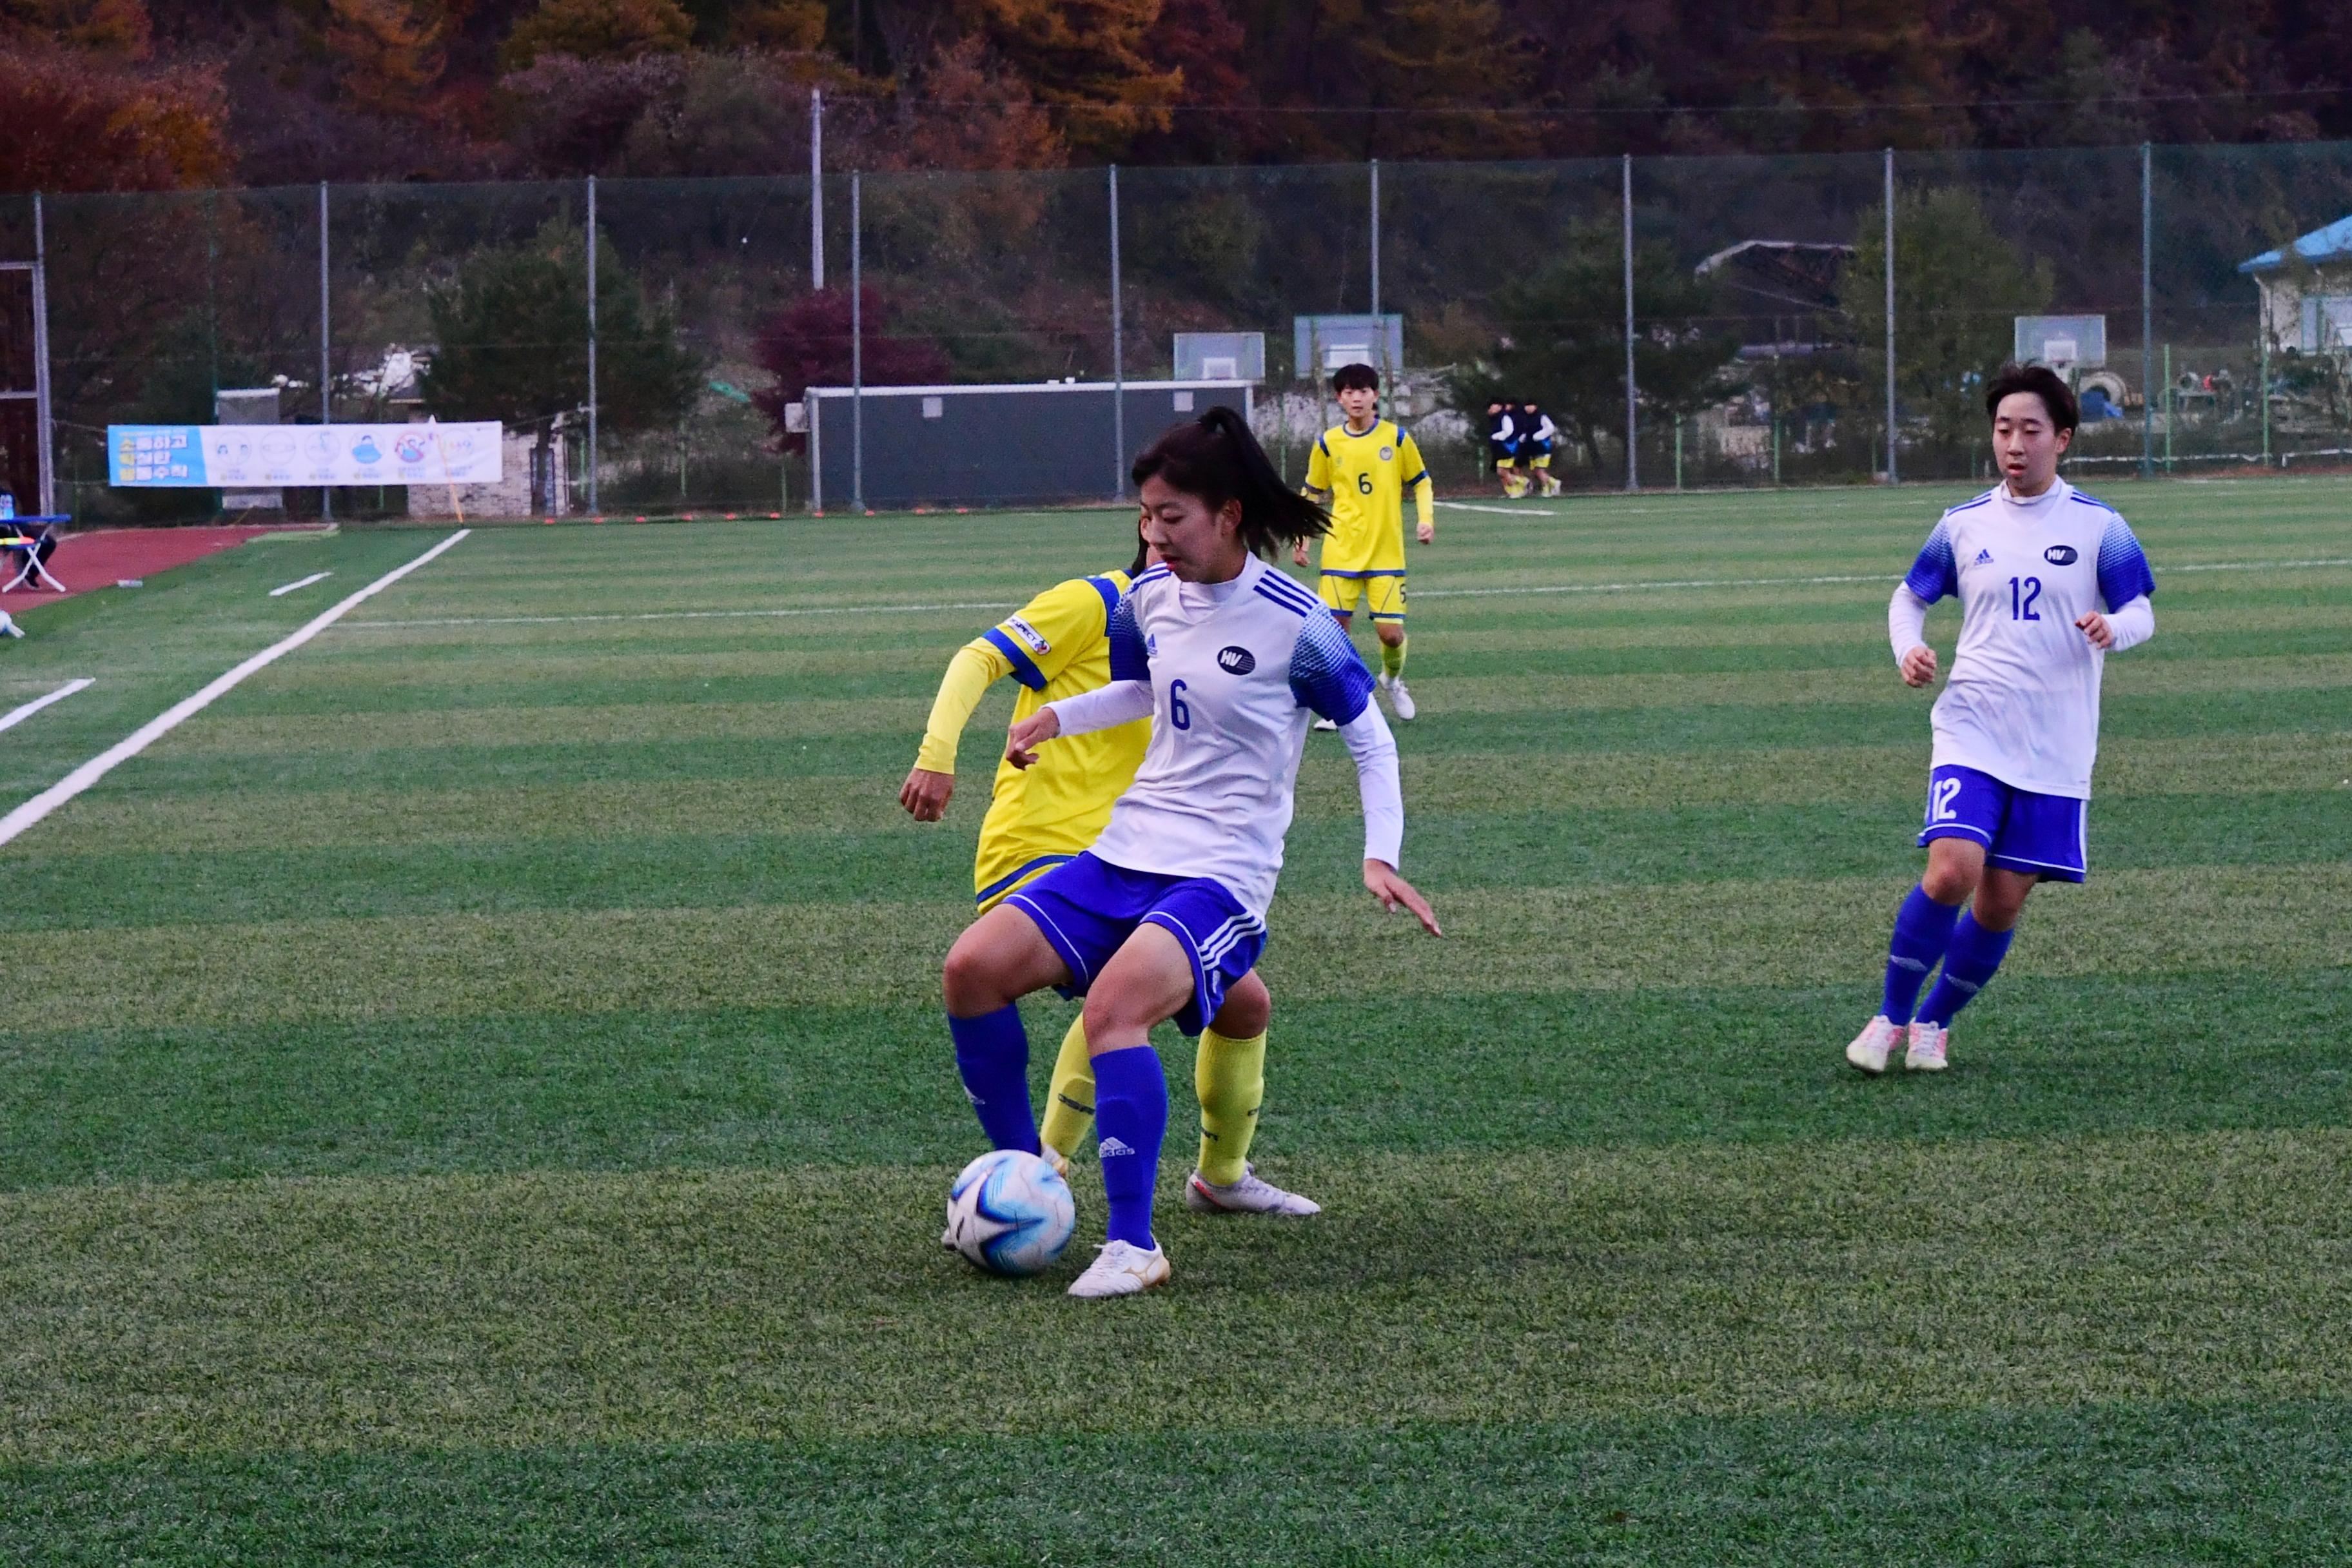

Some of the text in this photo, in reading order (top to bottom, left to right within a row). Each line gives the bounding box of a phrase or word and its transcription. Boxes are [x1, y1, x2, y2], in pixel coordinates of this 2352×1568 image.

[1358, 473, 1372, 495] 6
[2008, 576, 2041, 621] 12
[1171, 679, 1190, 730] 6
[1932, 778, 1961, 823] 12
